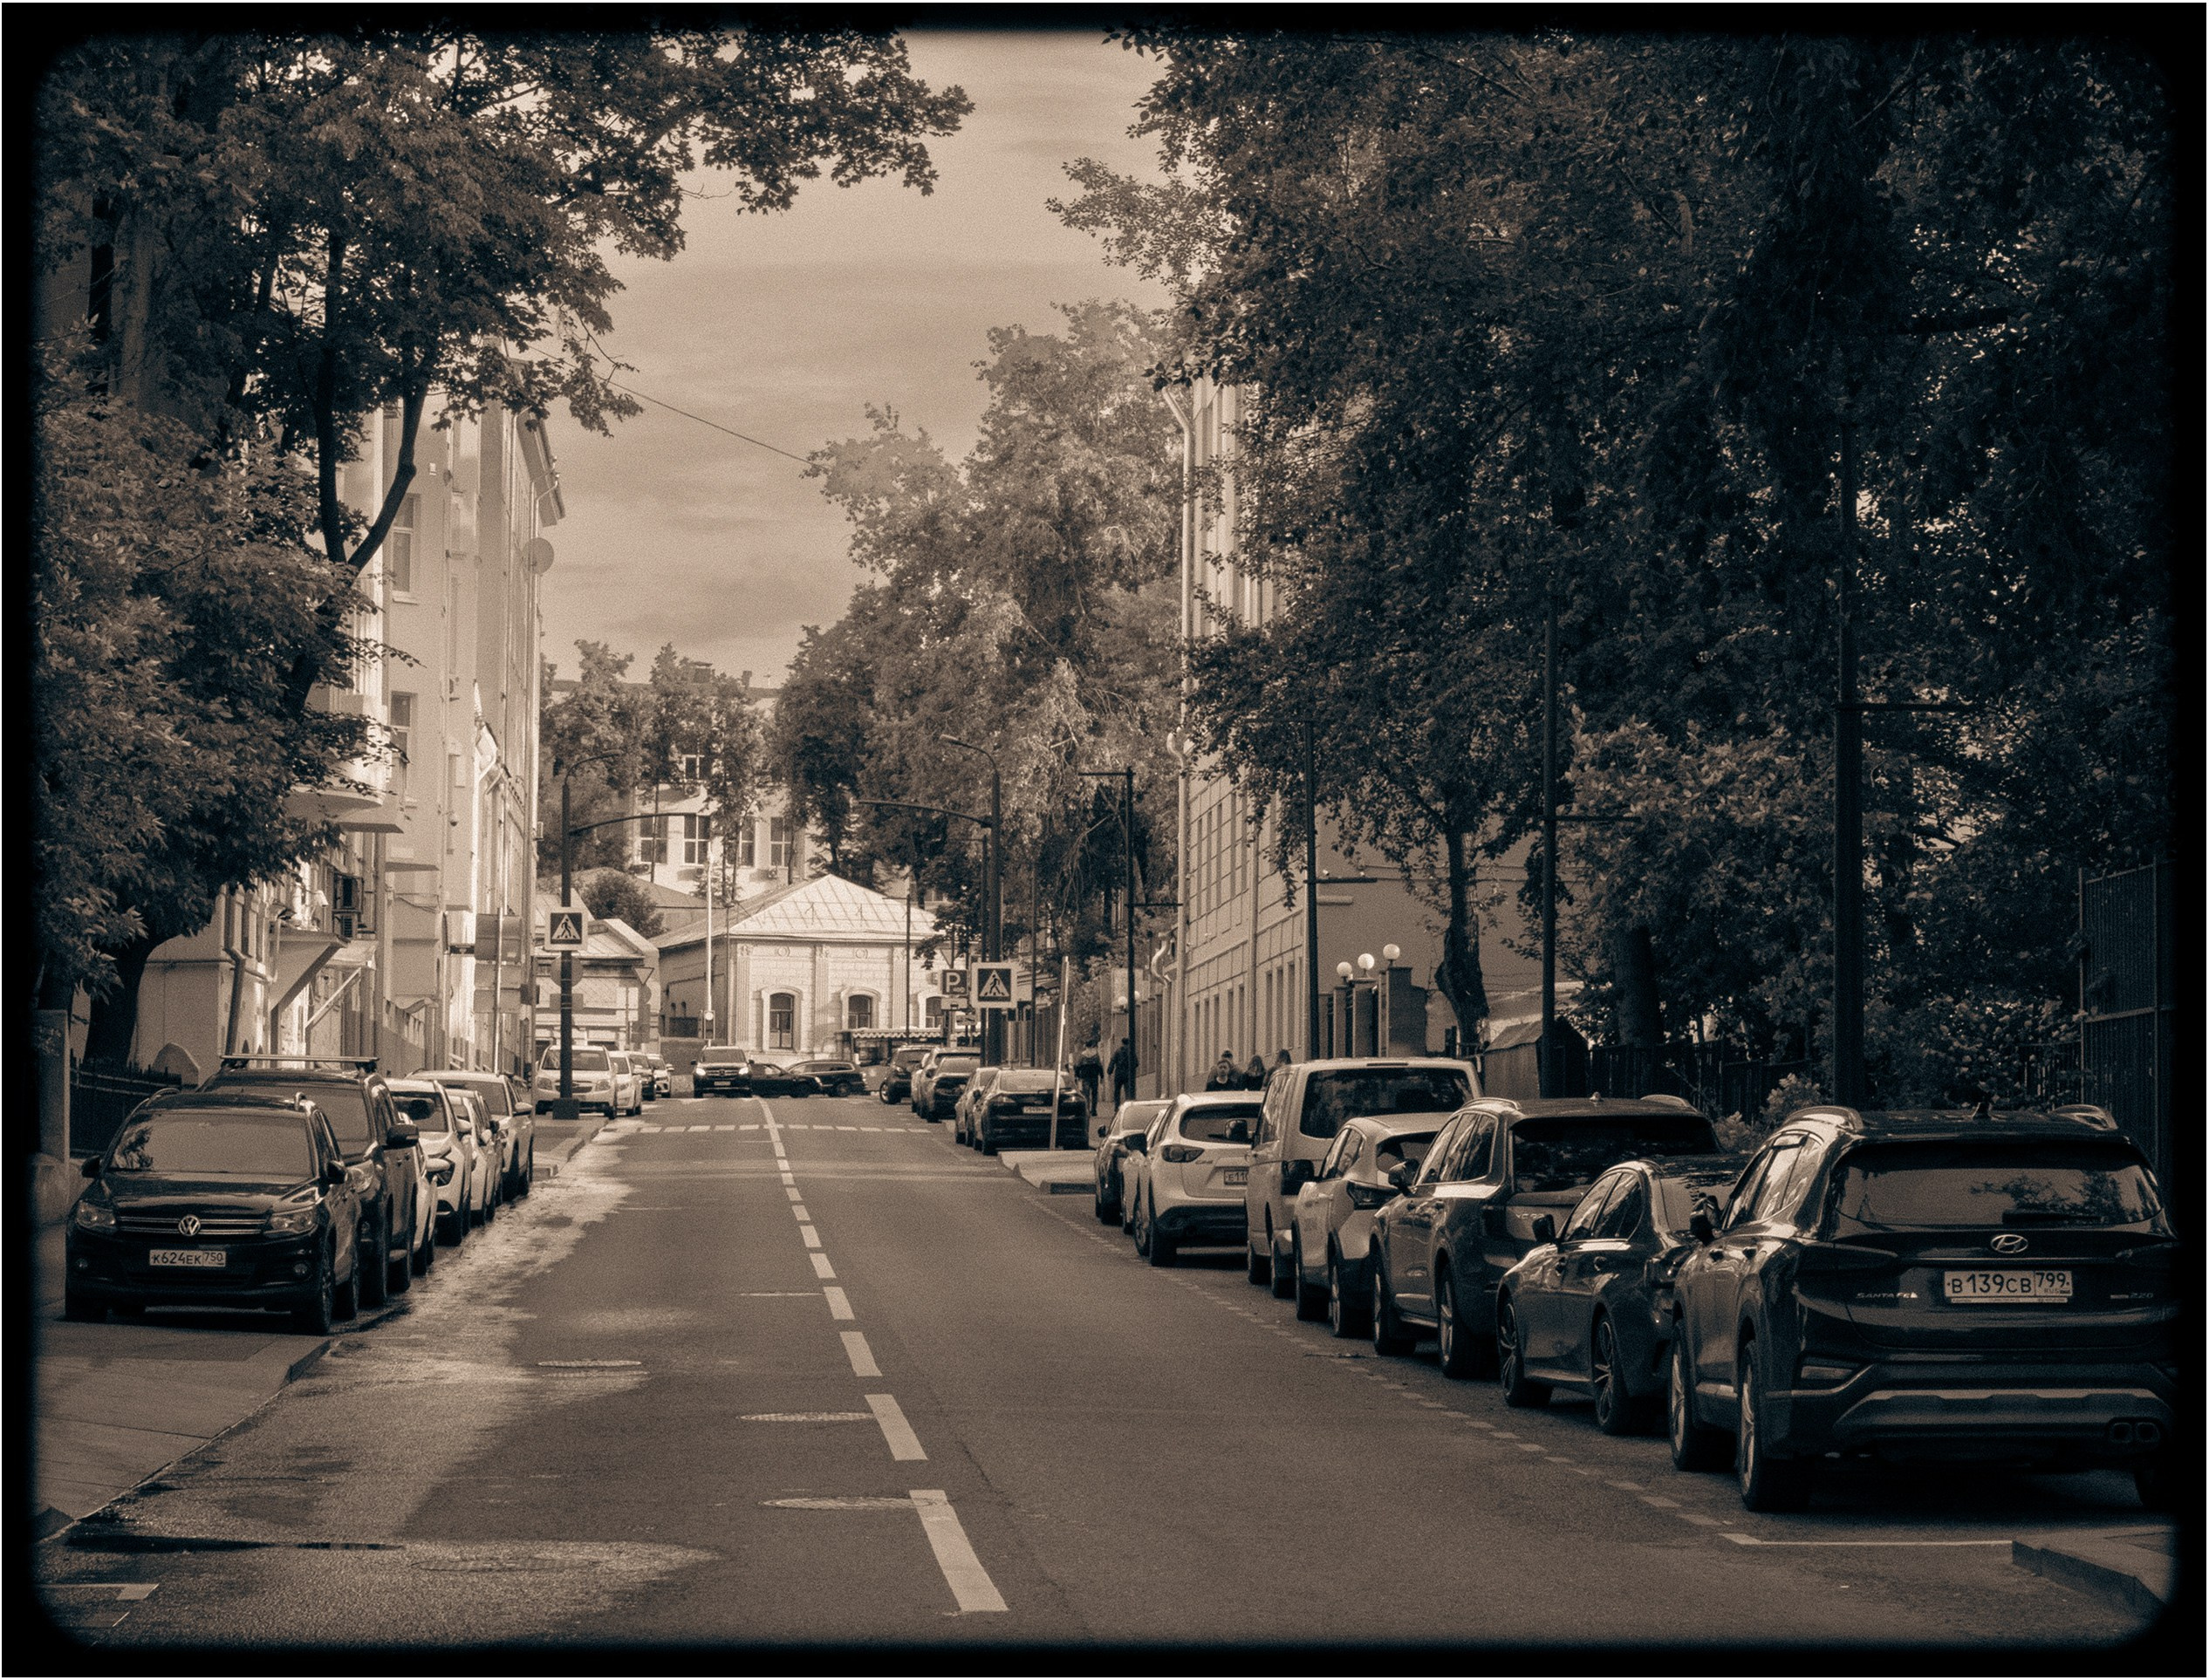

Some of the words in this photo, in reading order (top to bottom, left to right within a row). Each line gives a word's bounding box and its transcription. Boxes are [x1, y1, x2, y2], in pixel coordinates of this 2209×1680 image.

[946, 972, 961, 993] P
[204, 1252, 223, 1262] 750
[1952, 1274, 2032, 1294] В139СВ
[2035, 1272, 2066, 1287] 799
